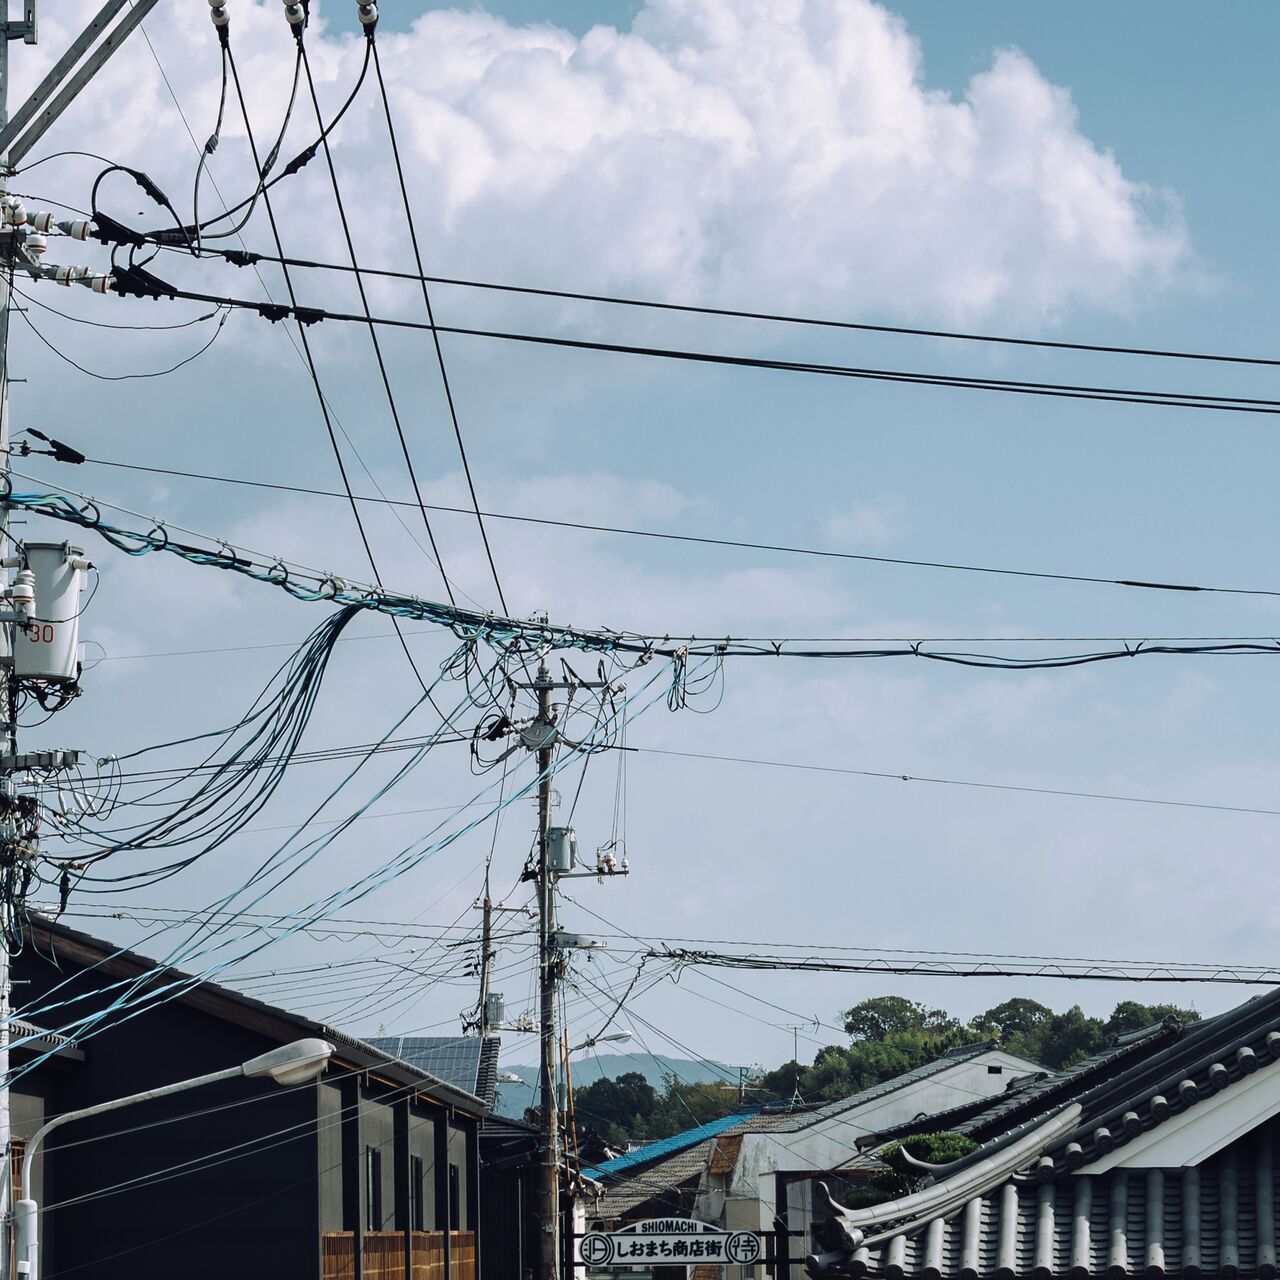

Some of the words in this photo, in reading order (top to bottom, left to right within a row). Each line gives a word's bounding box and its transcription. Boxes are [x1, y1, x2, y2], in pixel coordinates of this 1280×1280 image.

[30, 624, 54, 643] 30
[641, 1221, 697, 1233] SHIOMACHI
[617, 1239, 723, 1258] しおまち商店街
